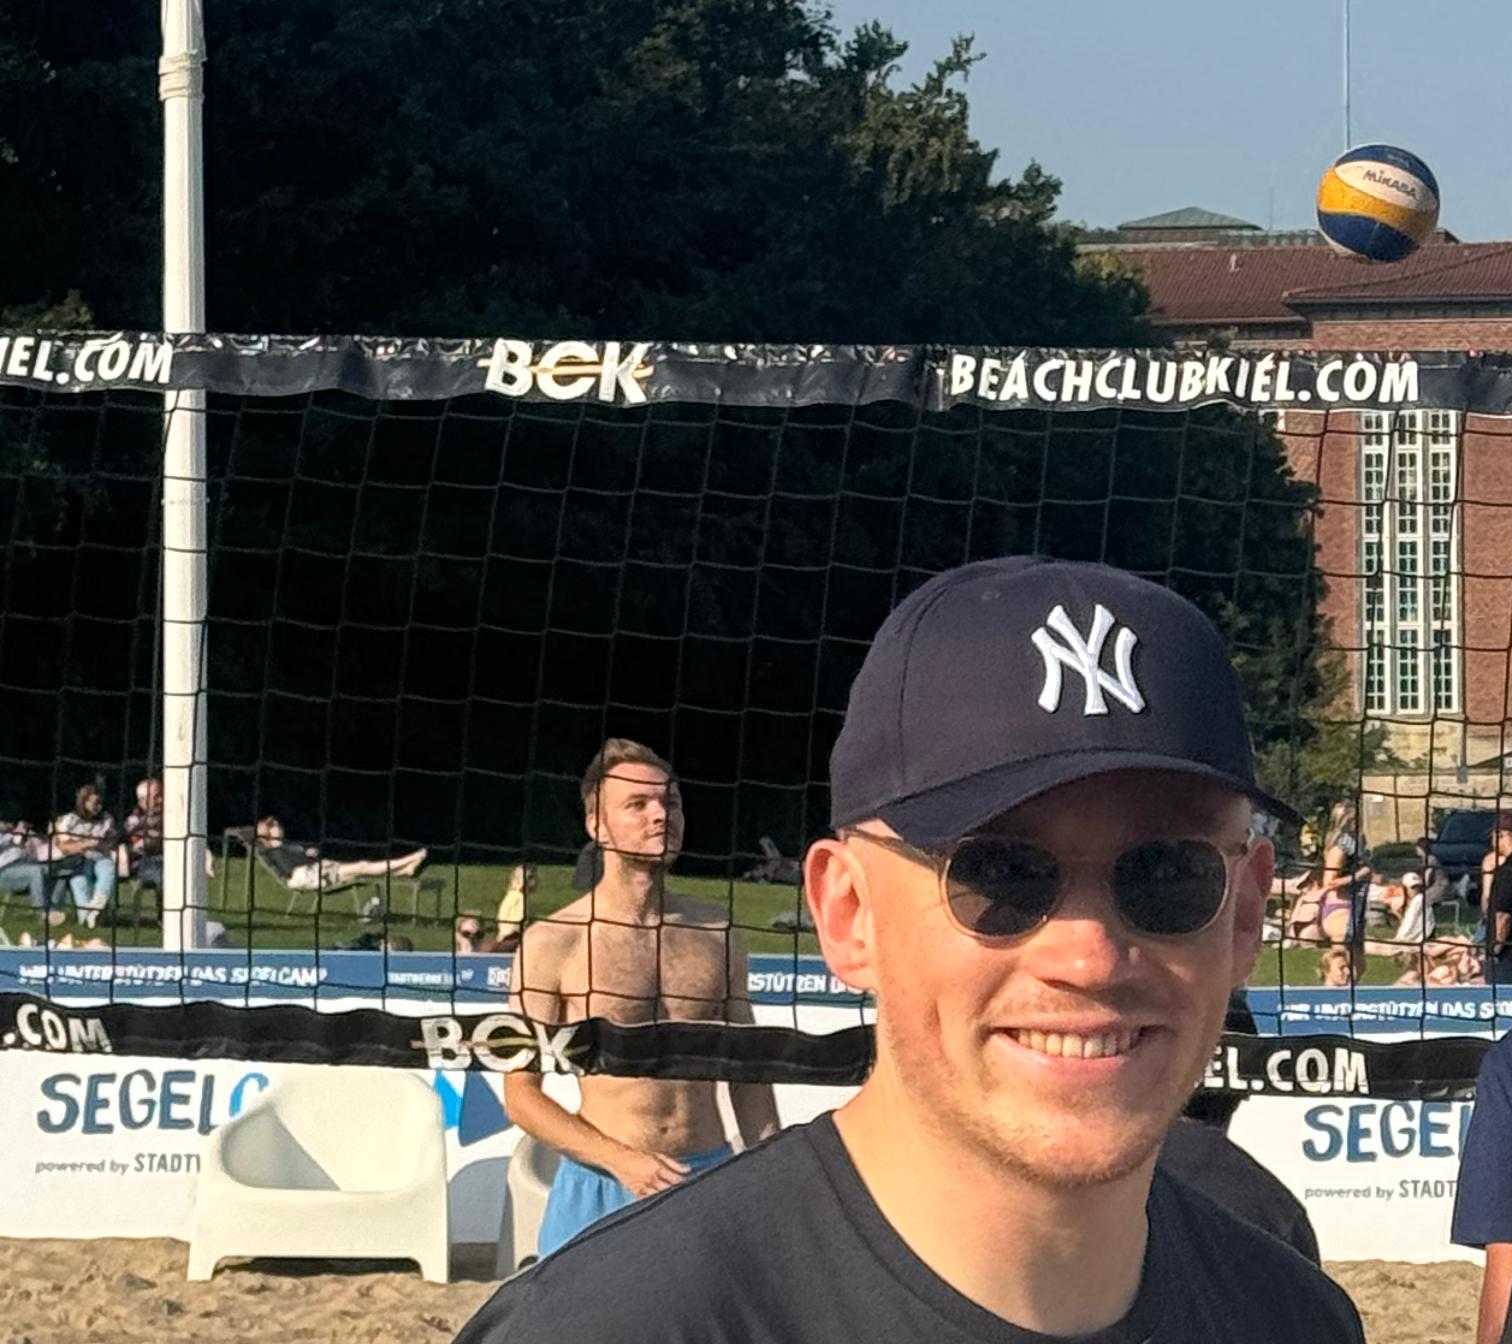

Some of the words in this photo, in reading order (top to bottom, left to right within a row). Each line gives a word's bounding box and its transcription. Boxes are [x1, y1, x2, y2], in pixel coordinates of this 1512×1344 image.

[949, 354, 1420, 404] BEACHCLUBKIEL.COM
[1442, 1002, 1476, 1019] DAS
[1194, 1046, 1369, 1094] EL.COM
[35, 1160, 105, 1174] powered
[110, 1160, 129, 1175] by
[1304, 1186, 1371, 1200] powered
[1376, 1186, 1394, 1201] by
